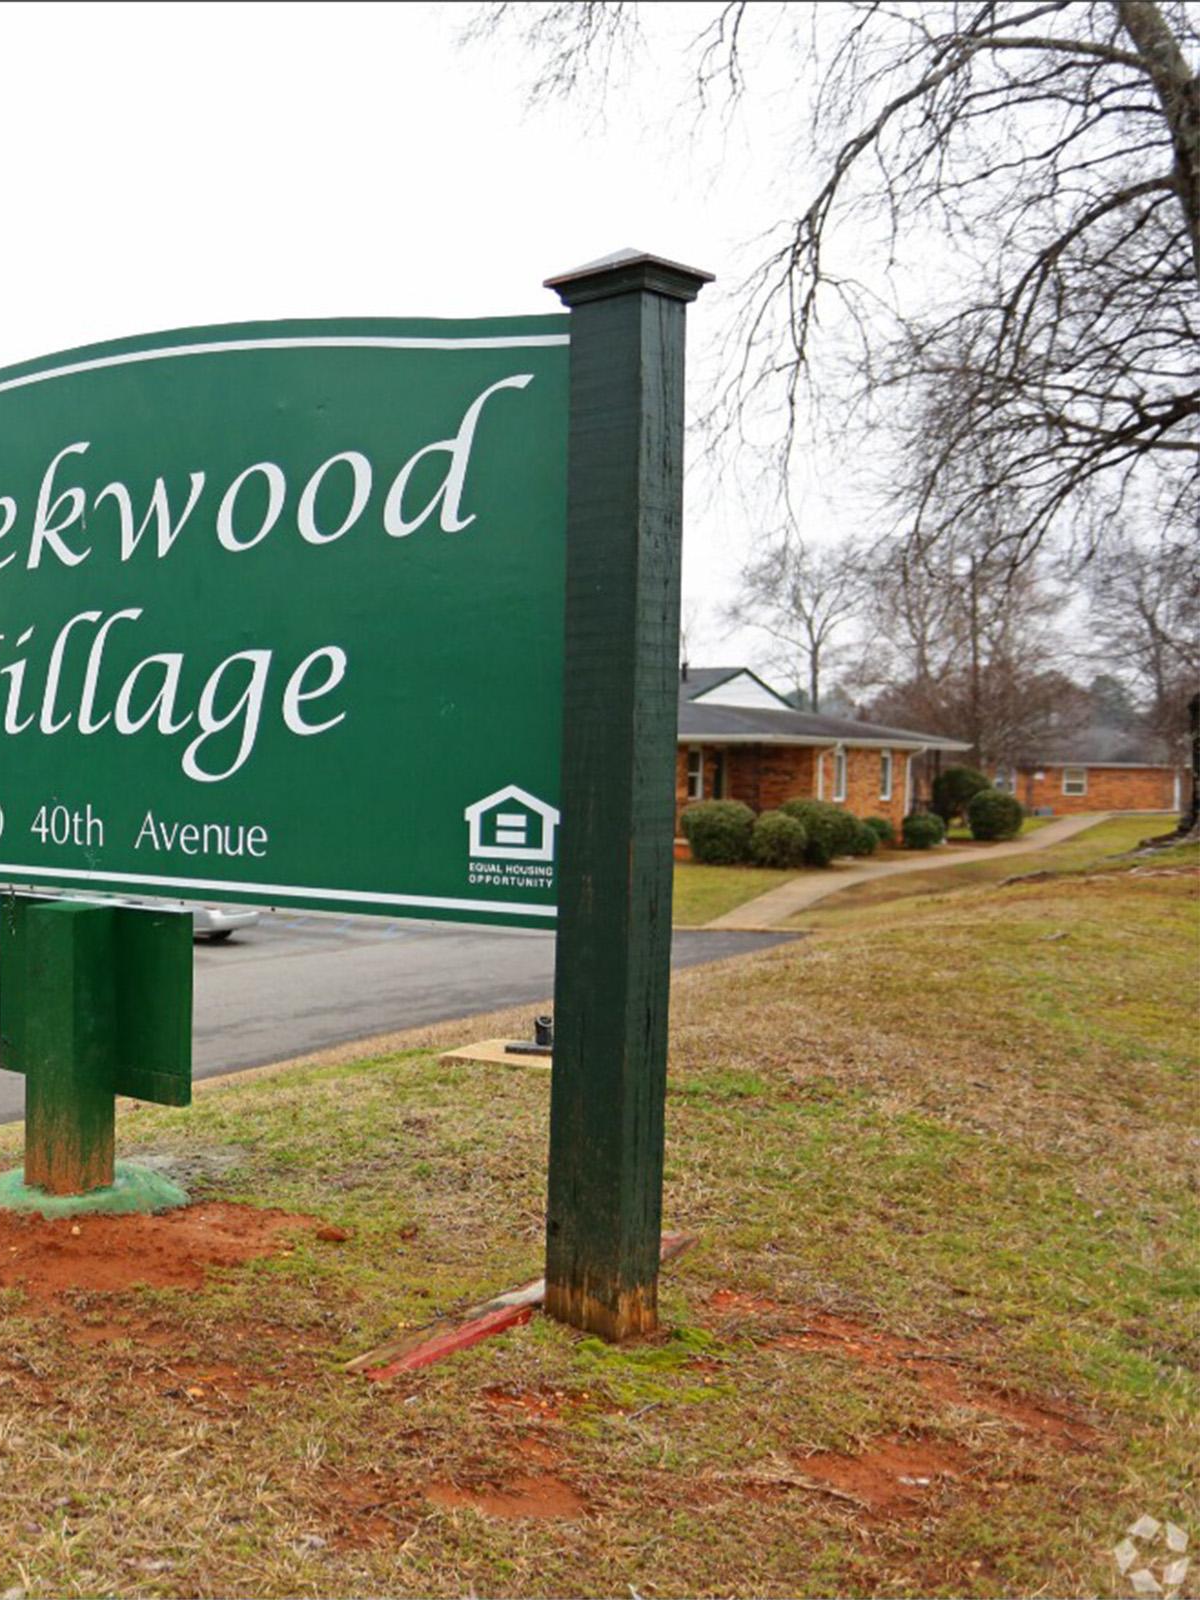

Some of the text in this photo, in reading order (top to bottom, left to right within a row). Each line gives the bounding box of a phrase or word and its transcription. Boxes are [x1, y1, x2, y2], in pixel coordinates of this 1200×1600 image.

[30, 804, 104, 847] 40th
[134, 811, 268, 857] Avenue
[469, 862, 553, 876] EQUAL HOUSING
[468, 874, 553, 888] OPPORTUNITY
